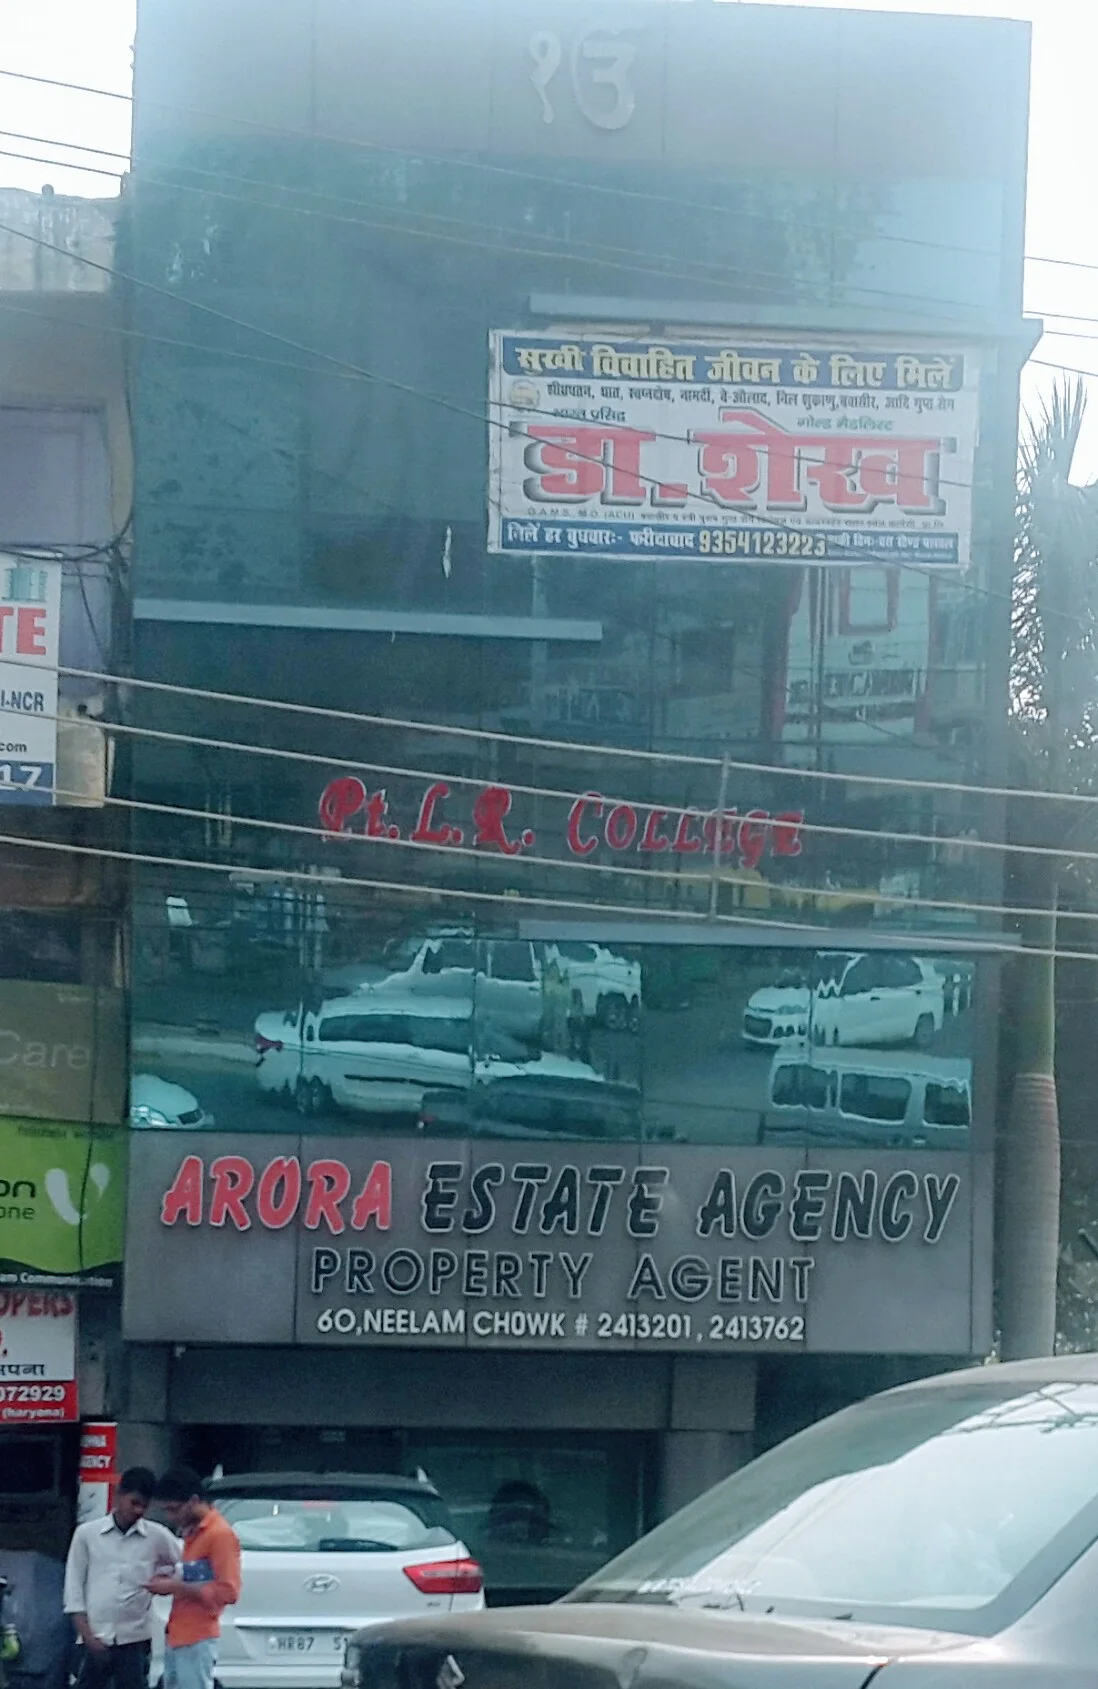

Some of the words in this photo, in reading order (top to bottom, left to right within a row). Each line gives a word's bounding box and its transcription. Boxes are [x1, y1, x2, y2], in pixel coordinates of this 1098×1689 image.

[515, 345, 586, 376] सुखी
[592, 345, 697, 381] विवाहित
[704, 348, 782, 383] जीवन
[793, 352, 820, 384] के
[828, 354, 887, 386] लिए
[896, 354, 955, 388] मिलें
[699, 529, 827, 557] 9354123223
[160, 1155, 393, 1235] ARORA
[420, 1160, 671, 1236] ESTATE
[695, 1168, 962, 1246] AGENCY
[310, 1247, 593, 1300] PROPERTY
[627, 1254, 816, 1305] AGENT
[473, 1311, 567, 1338] CHOWK
[709, 1315, 806, 1342] 2413762
